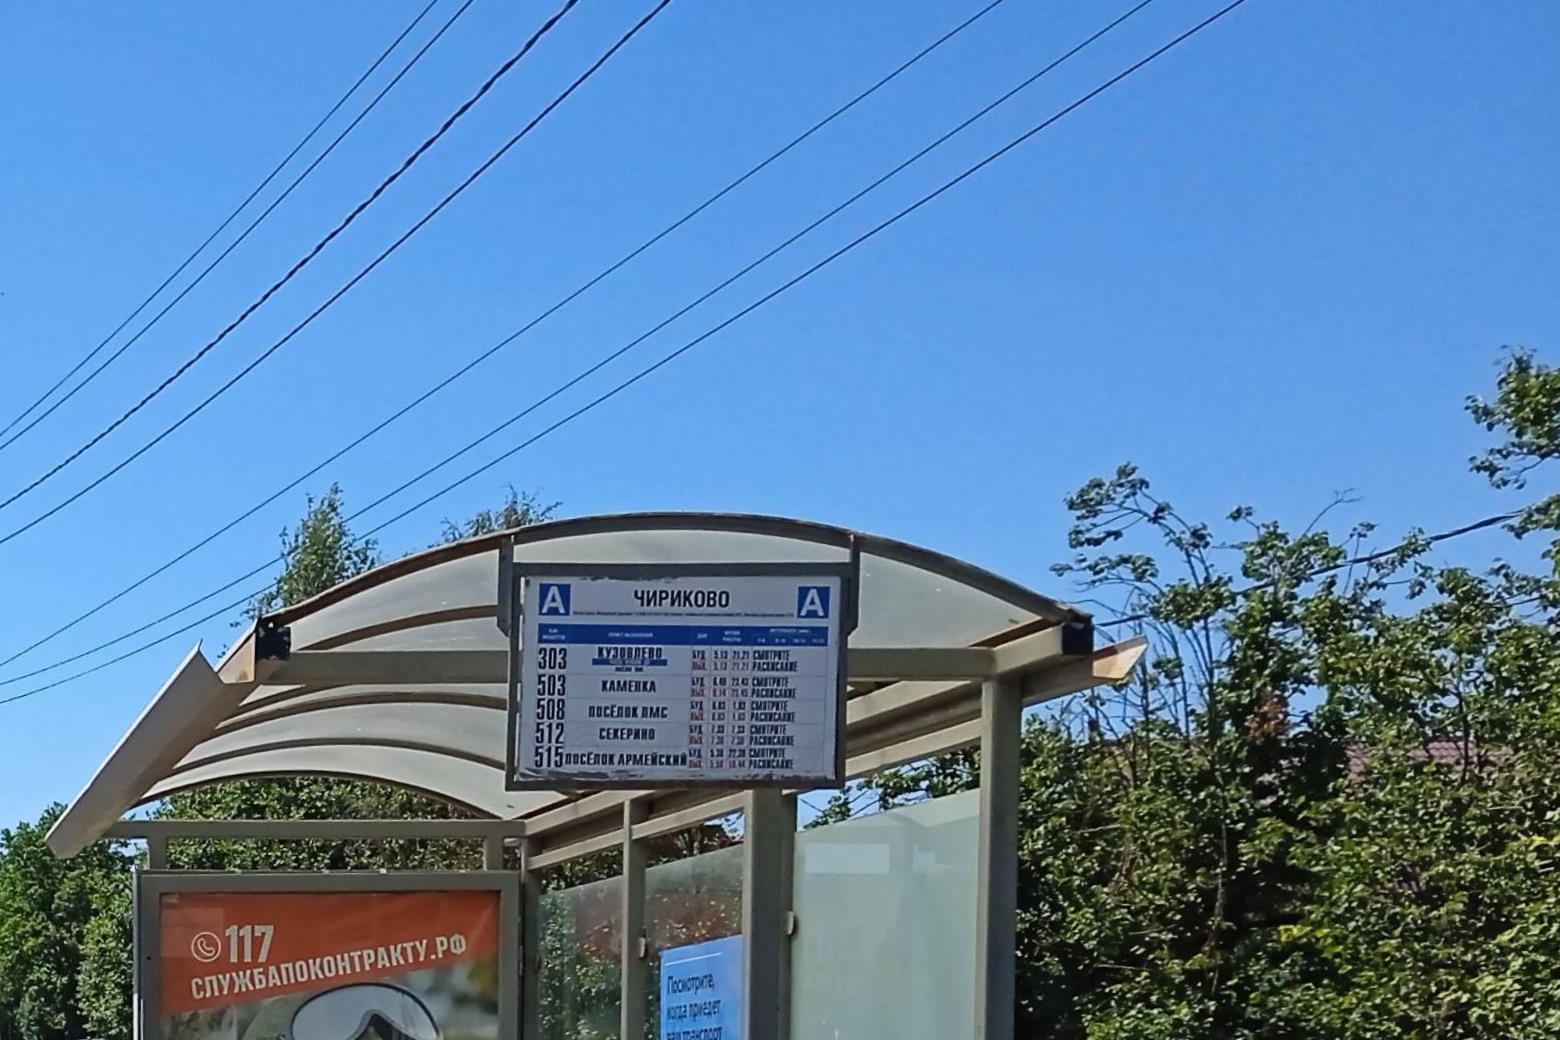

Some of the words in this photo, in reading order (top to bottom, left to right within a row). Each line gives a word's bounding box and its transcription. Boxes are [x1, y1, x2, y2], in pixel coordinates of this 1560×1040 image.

[633, 589, 730, 608] ЧИРИКОВО
[538, 648, 567, 670] 303
[598, 646, 663, 659] КУЗОВЛЕВО
[537, 675, 566, 696] 503
[601, 680, 656, 693] КАМЕНКА
[536, 698, 566, 720] 508
[589, 704, 639, 718] ПОСЁЛОК
[536, 722, 565, 744] 512
[599, 728, 656, 740] СЕКЕРИНО
[534, 746, 564, 768] 515
[565, 752, 616, 766] ПОСЁЛОК
[618, 752, 687, 767] АРМЕЙСКИЙ
[224, 925, 274, 963] 117
[190, 934, 467, 1000] СЛУЖБАПОКОНТРАКТУ.РФ
[666, 972, 715, 996] Посмотрите,
[666, 1003, 688, 1022] когда
[689, 998, 722, 1021] приедет
